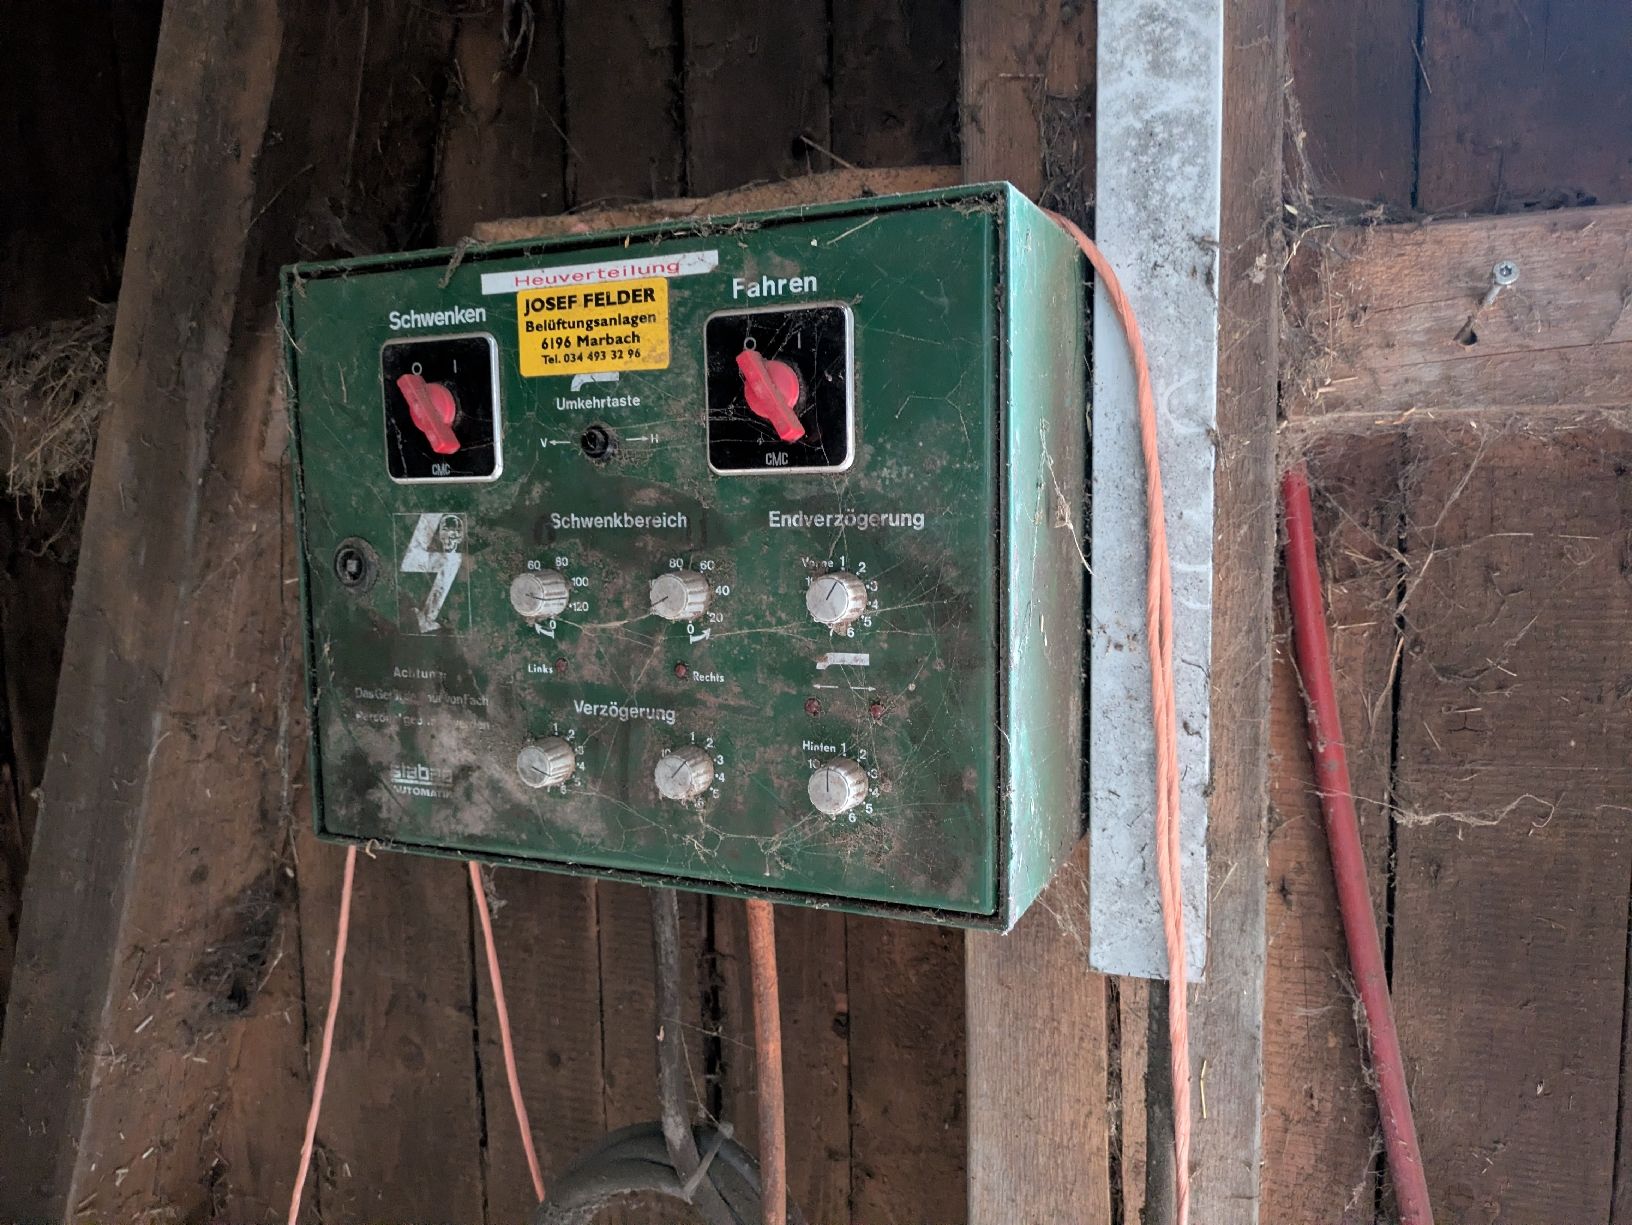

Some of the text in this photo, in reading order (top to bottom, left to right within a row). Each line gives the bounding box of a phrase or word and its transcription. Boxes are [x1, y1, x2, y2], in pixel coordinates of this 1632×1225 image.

[514, 261, 680, 287] Heuverteilung
[732, 275, 817, 299] Fahren
[524, 287, 656, 316] JOSEF FELDER
[389, 305, 486, 330] Schwenken
[526, 312, 656, 333] Belüftungsanlagen
[541, 332, 640, 351] 6196 Marbach
[542, 348, 641, 365] Tel. 034 493 32 96
[556, 395, 641, 410] Umkehrtaste
[540, 438, 547, 448] V
[651, 433, 659, 444] H
[766, 451, 789, 466] CMC
[432, 464, 451, 476] CMC
[550, 512, 688, 529] Schwenkbereich
[768, 508, 924, 530] Endverzögerung
[528, 560, 541, 570] 60
[669, 558, 684, 568] 80
[700, 560, 715, 570] 60
[858, 562, 866, 573] 2
[572, 577, 589, 587] 100
[870, 581, 878, 592] 3
[715, 585, 730, 596] 40
[572, 602, 589, 612] 120
[709, 612, 723, 623] 20
[864, 617, 872, 627] 5
[549, 620, 556, 630] 0
[687, 624, 694, 634] 0
[847, 628, 855, 638] 6
[528, 664, 553, 674] Links
[693, 671, 725, 683] Rechts
[574, 698, 676, 725] Verzögerung
[568, 729, 575, 739] 2
[707, 738, 714, 748] 2
[802, 740, 836, 753] Hinten
[717, 755, 724, 765] 3
[860, 749, 866, 760] 2
[718, 772, 725, 782] 4
[870, 768, 878, 779] 3
[866, 804, 873, 814] 5
[849, 813, 856, 822] 6
